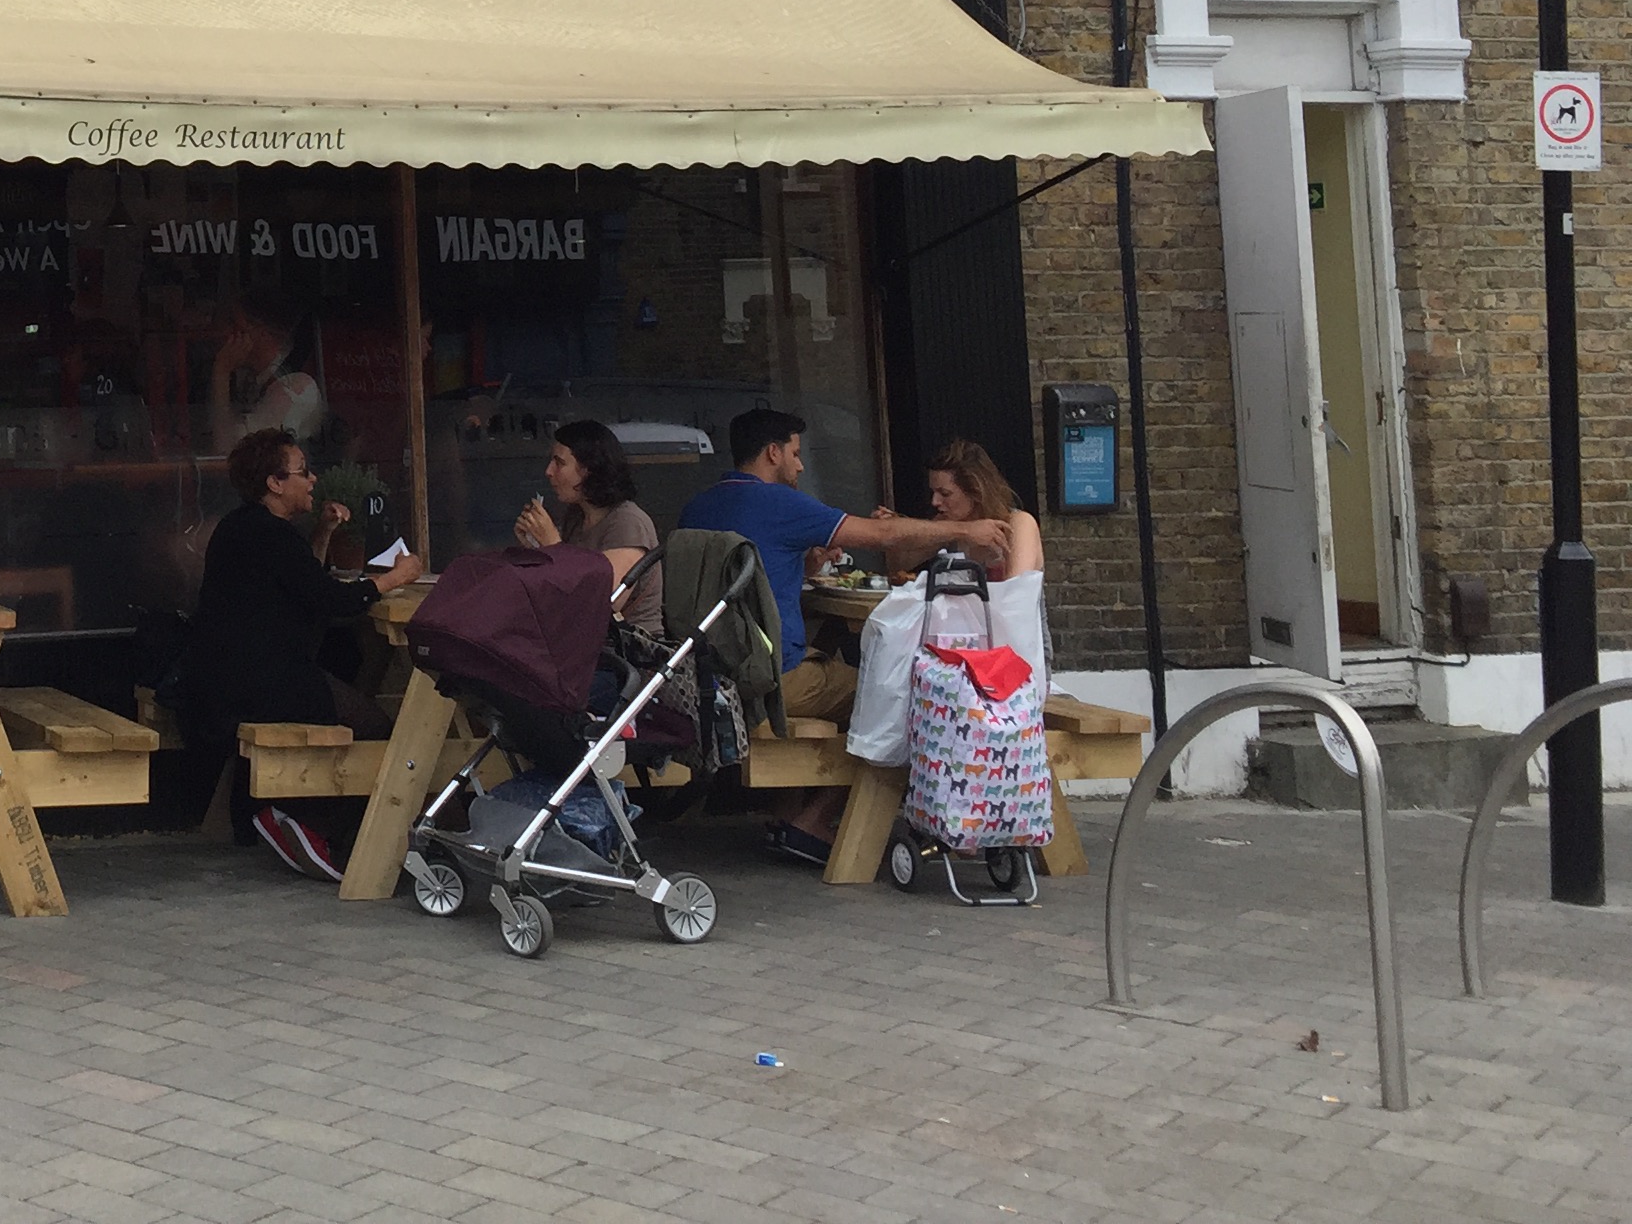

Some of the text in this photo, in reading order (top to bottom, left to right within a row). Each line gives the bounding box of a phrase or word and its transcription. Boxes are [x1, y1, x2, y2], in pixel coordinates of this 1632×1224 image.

[67, 118, 346, 156] Coffee Restaurant
[369, 496, 384, 515] 10
